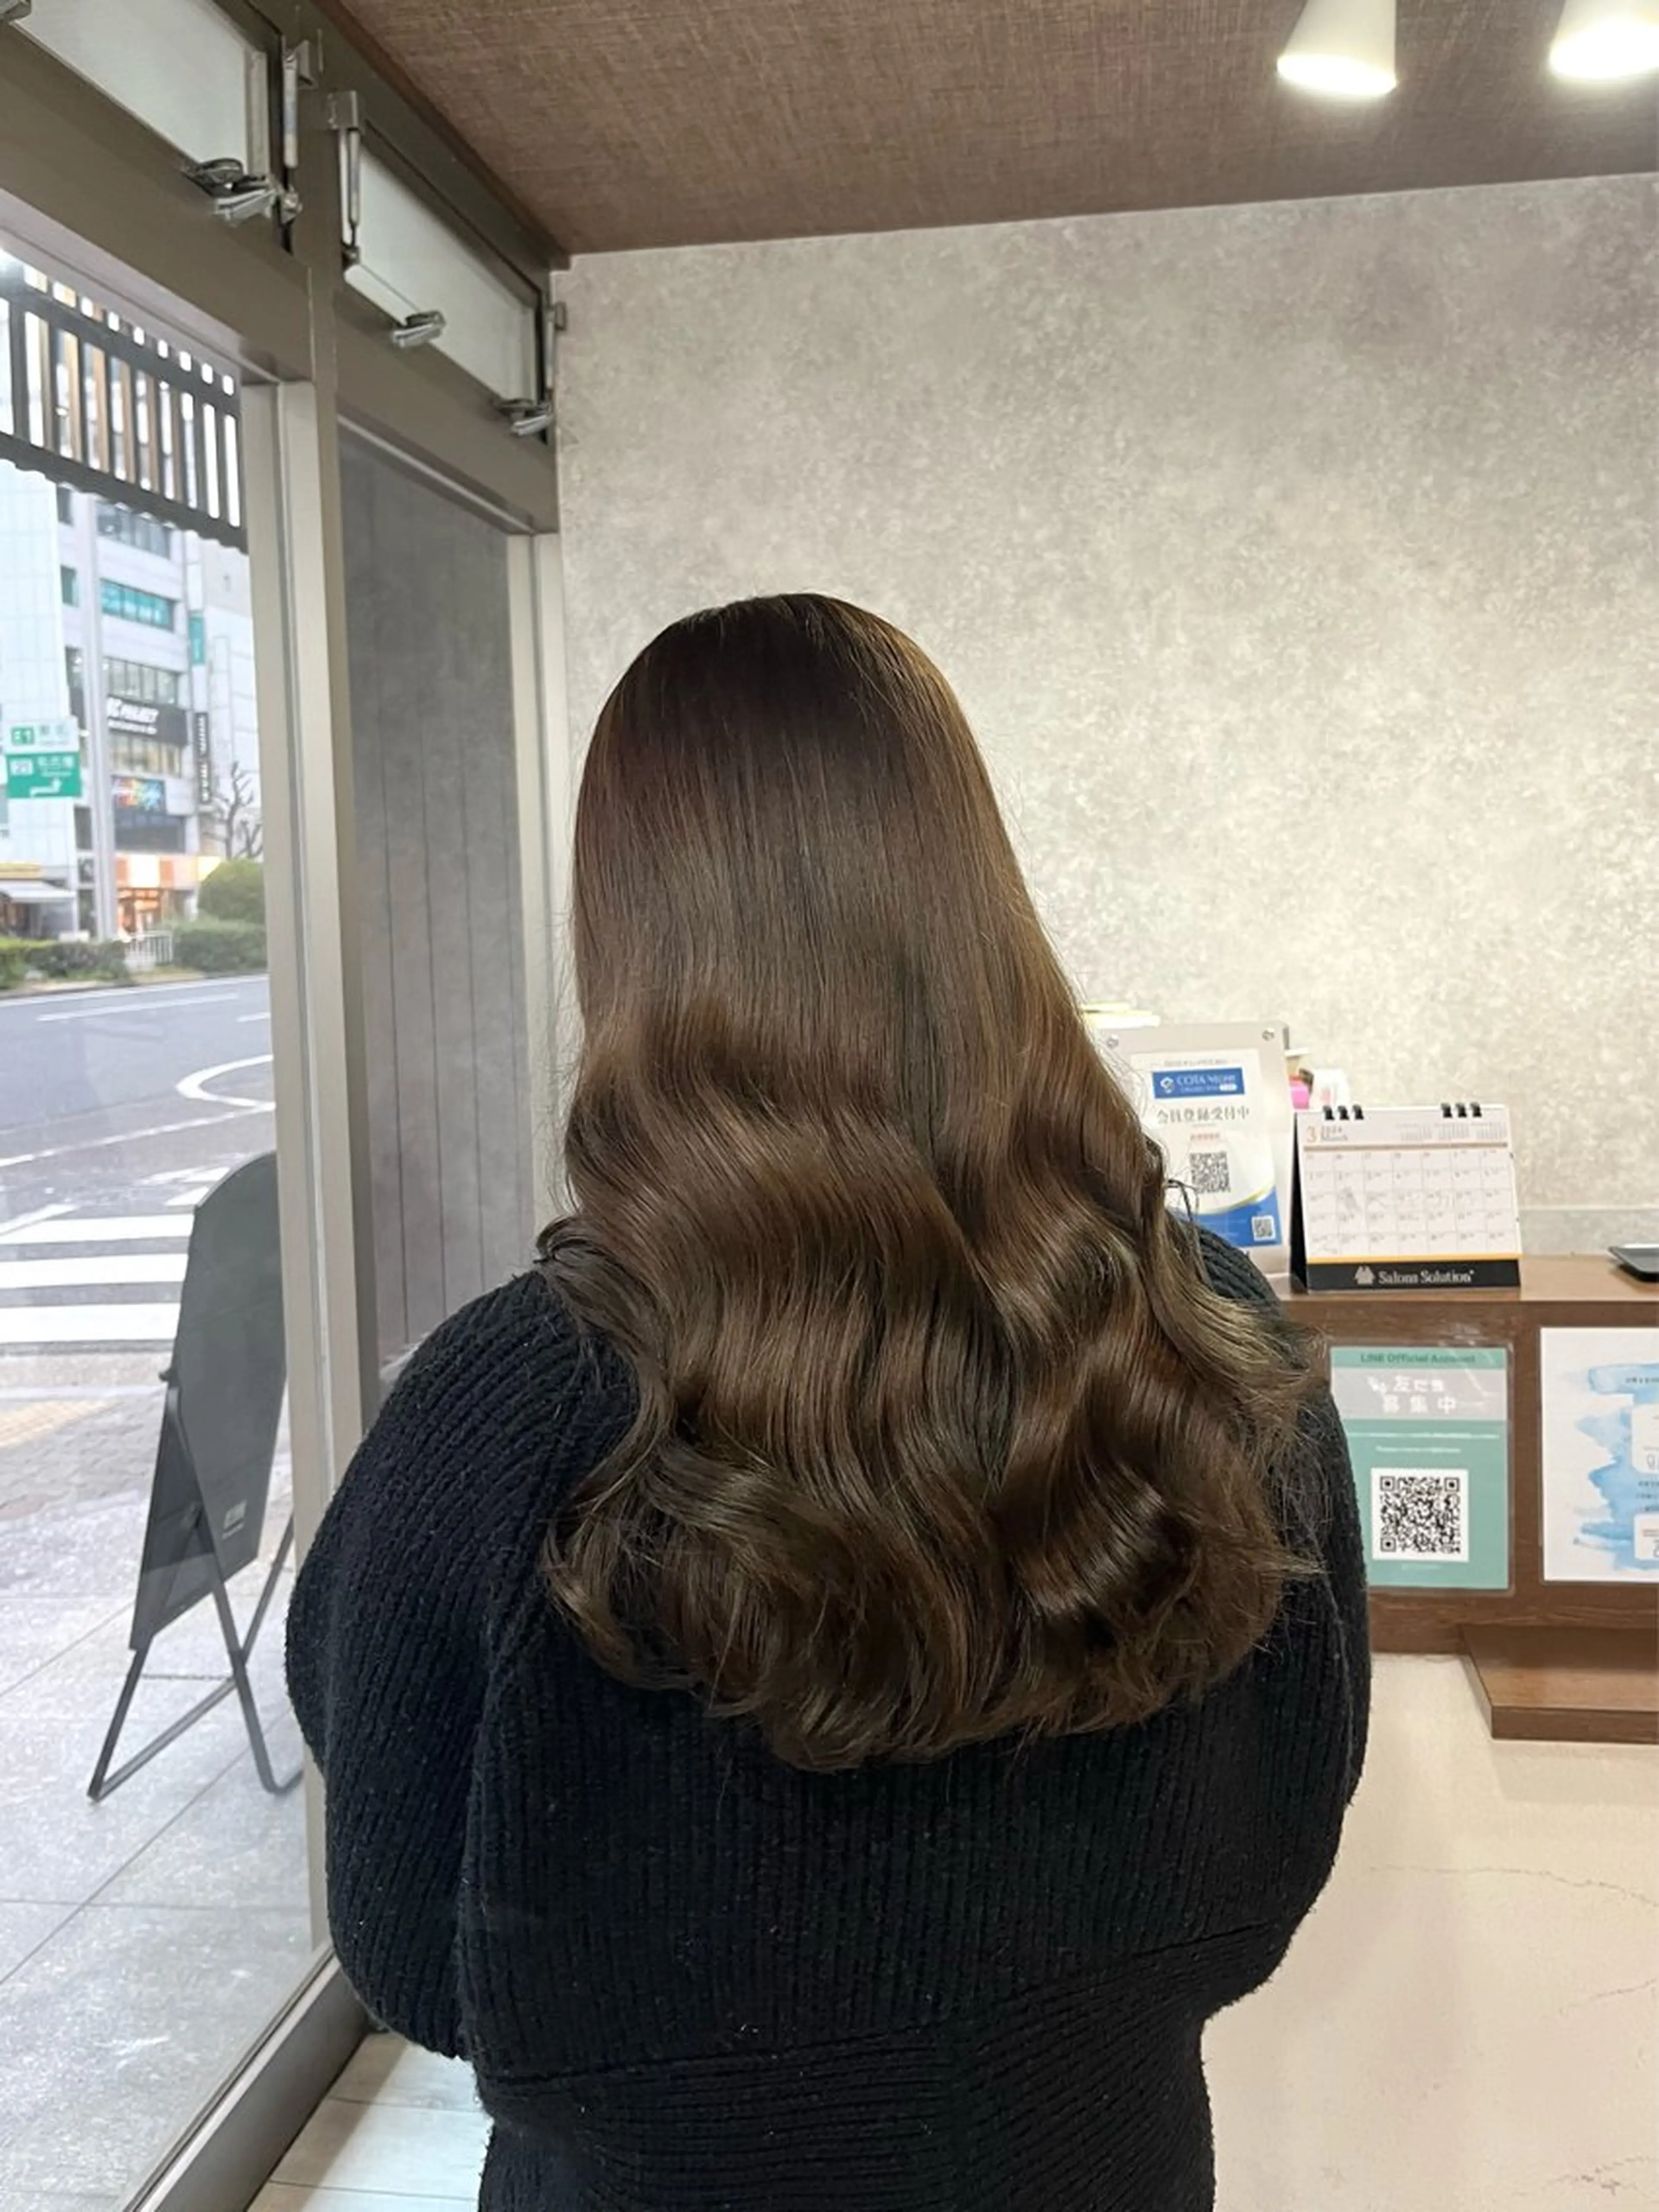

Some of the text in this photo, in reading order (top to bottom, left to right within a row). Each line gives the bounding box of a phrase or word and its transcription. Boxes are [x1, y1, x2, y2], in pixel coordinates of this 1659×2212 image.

[1157, 1105, 1249, 1124] 会員登録受付中
[1307, 1125, 1317, 1143] 3
[1361, 1353, 1384, 1363] LINE
[1387, 1353, 1428, 1363] Official
